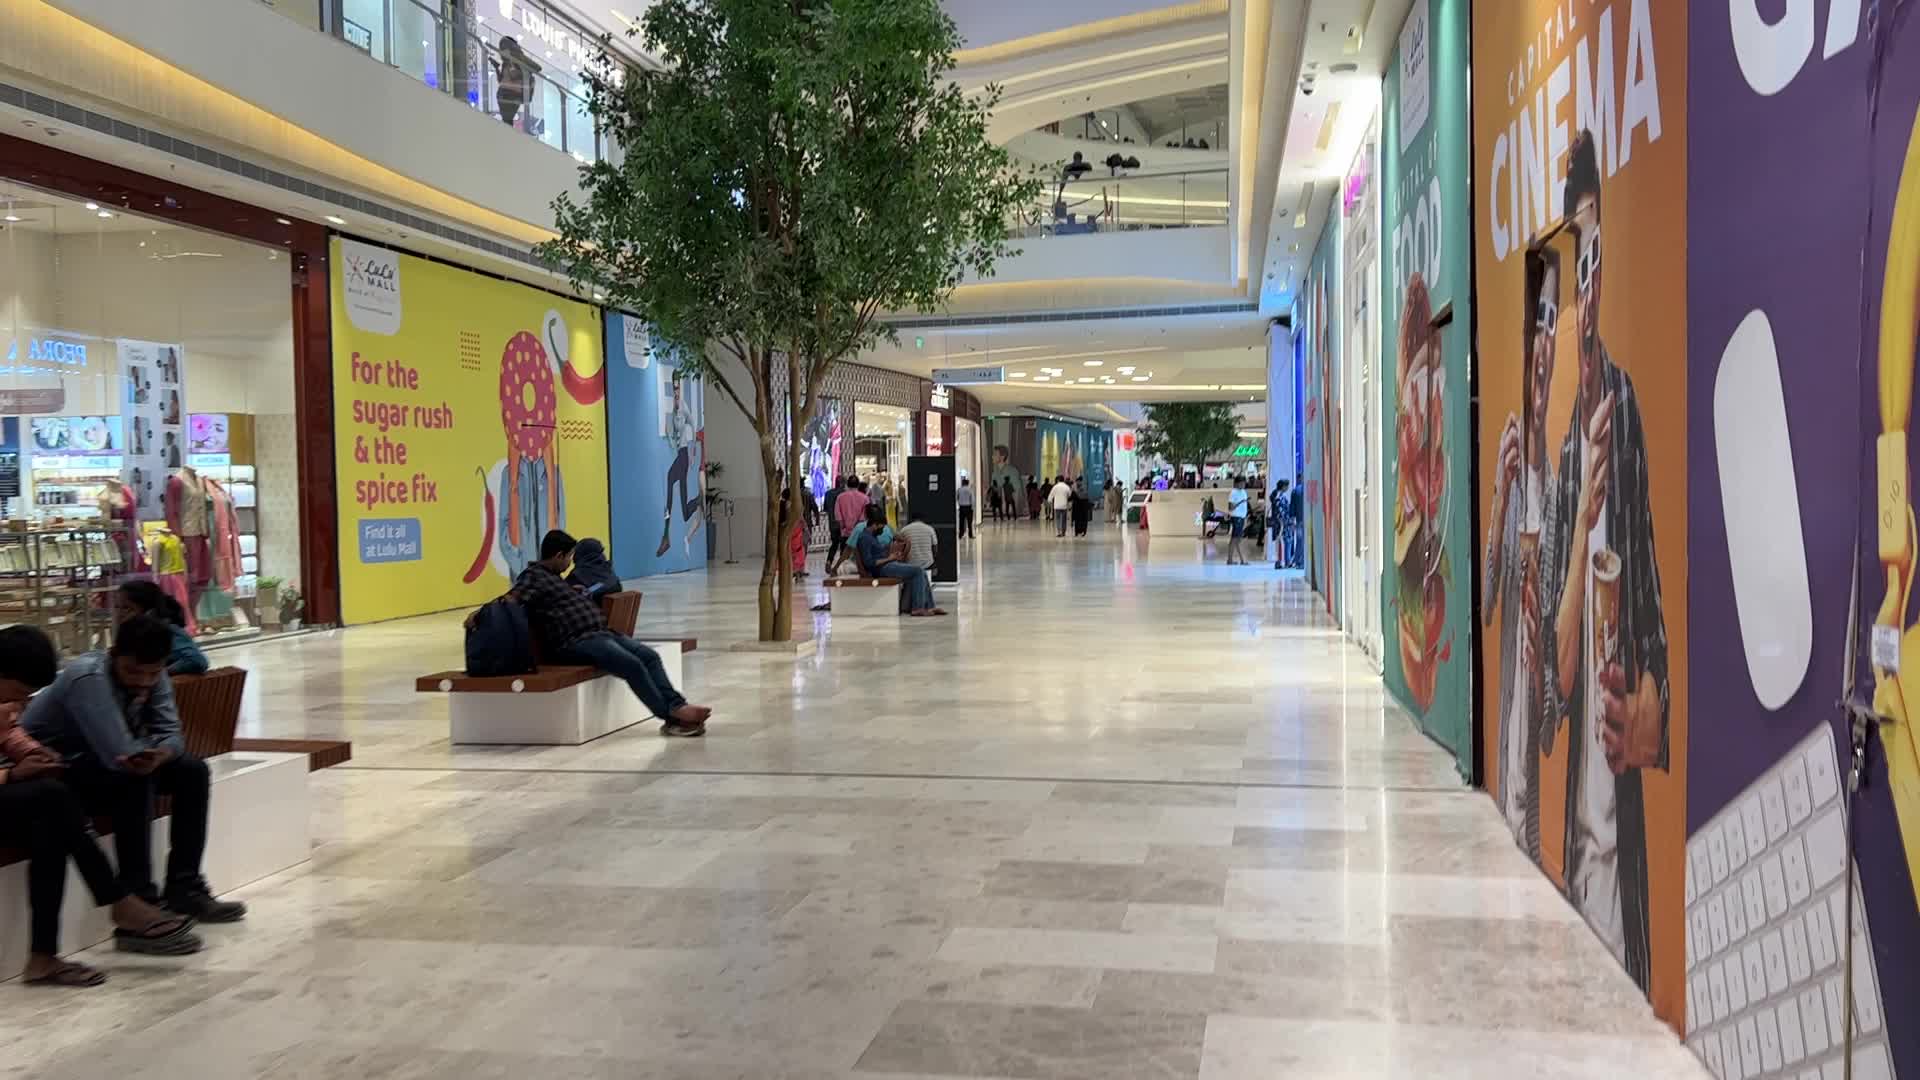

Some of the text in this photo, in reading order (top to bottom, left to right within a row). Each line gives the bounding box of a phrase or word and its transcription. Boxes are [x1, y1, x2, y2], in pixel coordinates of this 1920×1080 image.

[1508, 0, 1577, 106] CAPITAL
[1490, 0, 1662, 262] CINEMA
[1393, 154, 1424, 221] CAPITAL
[1392, 175, 1441, 321] FOOD
[367, 276, 397, 292] MALL
[387, 360, 418, 390] the
[353, 400, 453, 432] sugar rush
[355, 435, 407, 465] & the
[356, 472, 437, 511] spice fix
[365, 525, 385, 540] Find
[393, 525, 406, 539] all
[367, 545, 377, 557] at
